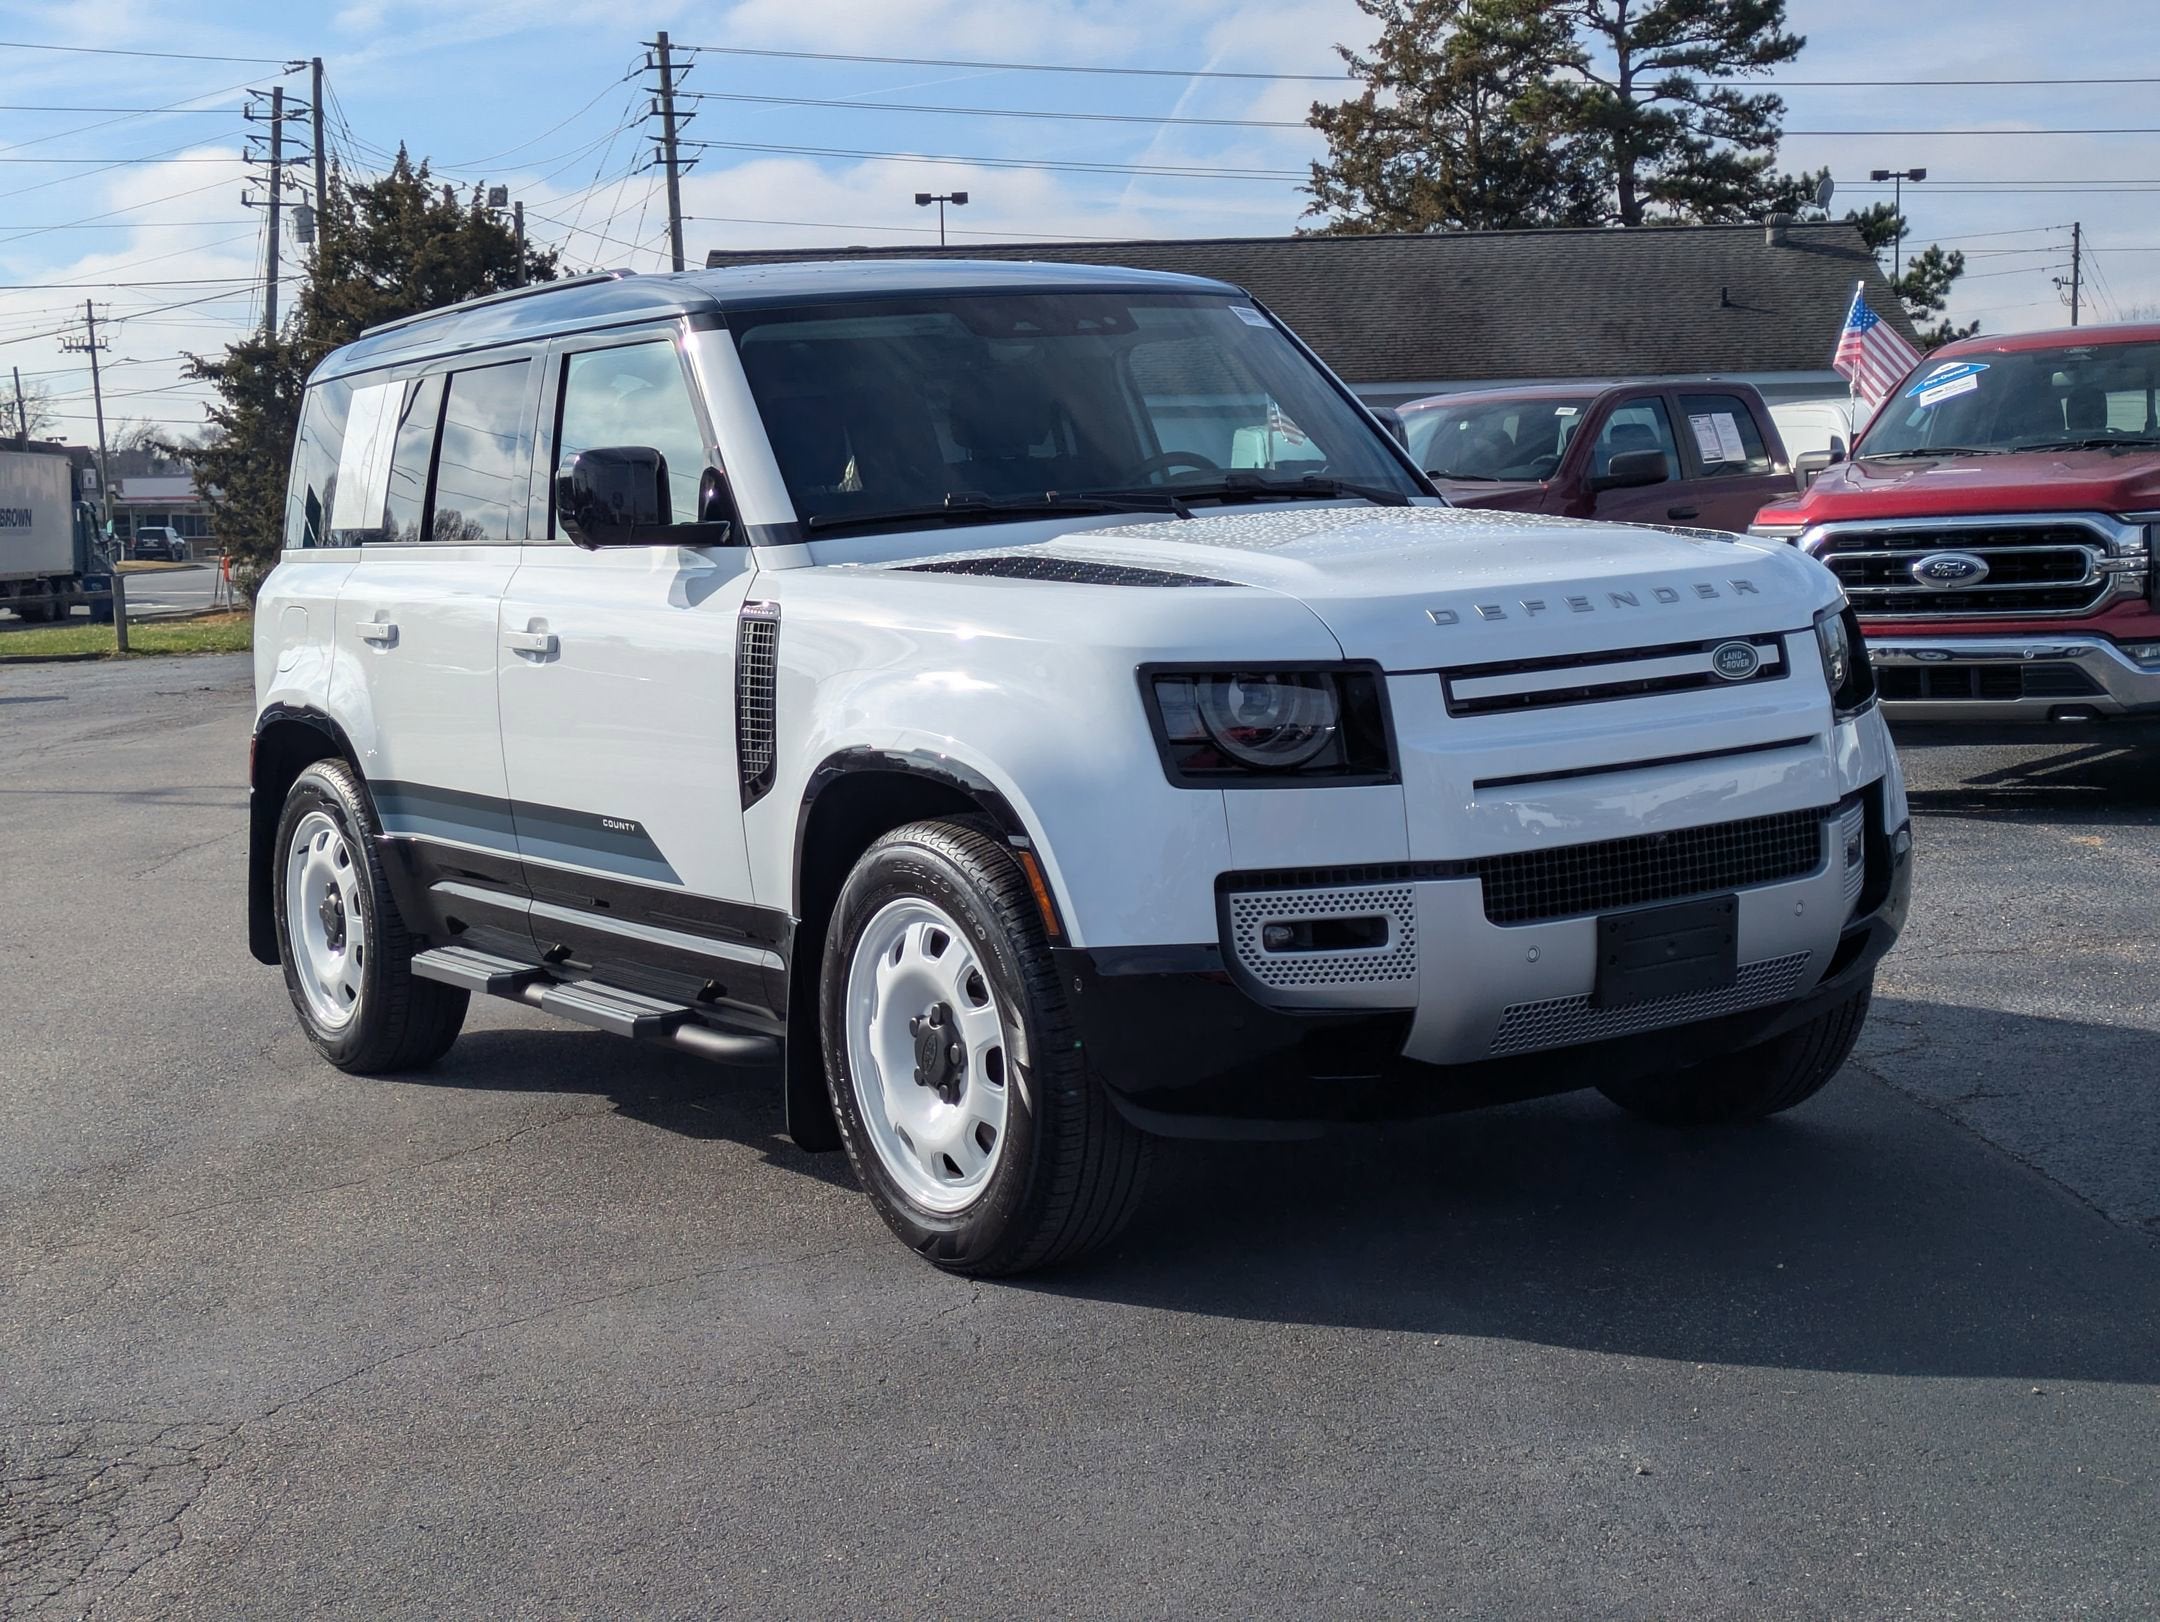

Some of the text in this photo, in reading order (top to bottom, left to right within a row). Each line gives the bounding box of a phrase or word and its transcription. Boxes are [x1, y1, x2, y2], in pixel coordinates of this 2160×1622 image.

[1931, 561, 1967, 577] Ford
[1425, 579, 1760, 626] DEFENDER
[602, 818, 635, 832] COUNTY
